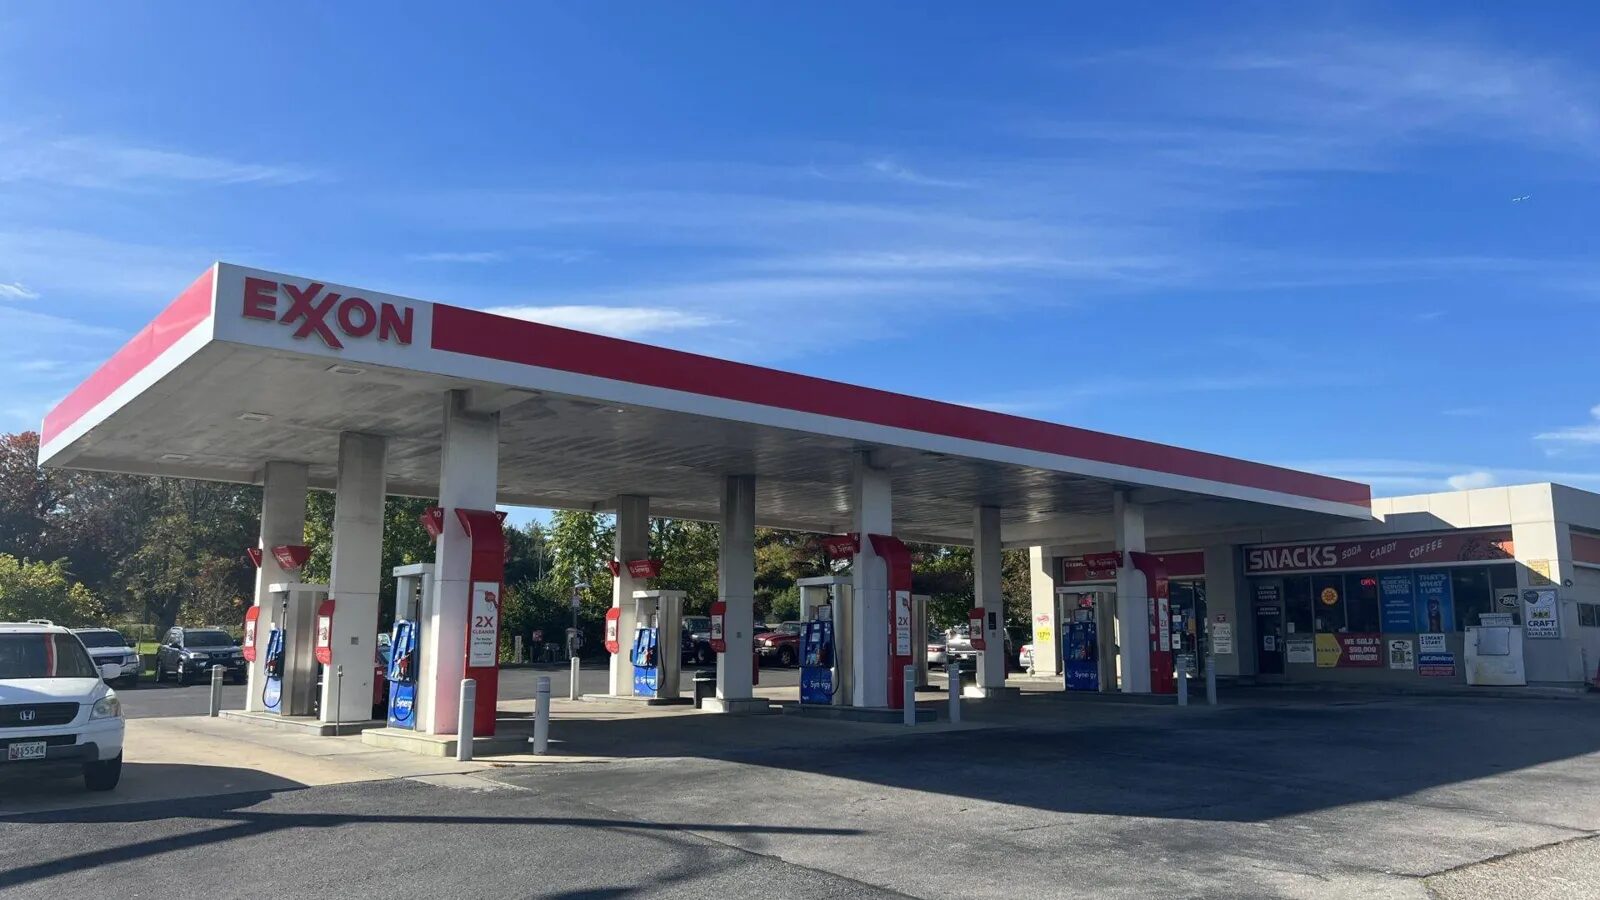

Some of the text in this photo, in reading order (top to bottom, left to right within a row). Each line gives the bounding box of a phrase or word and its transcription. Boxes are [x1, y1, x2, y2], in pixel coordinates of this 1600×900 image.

[242, 276, 414, 350] EXXON
[433, 510, 441, 518] 10
[1249, 538, 1443, 570] SNACKS SODA CANDY COFFEE
[475, 616, 493, 628] 2X
[898, 617, 908, 626] 2X
[1356, 637, 1373, 645] SOLD
[1374, 637, 1380, 645] A
